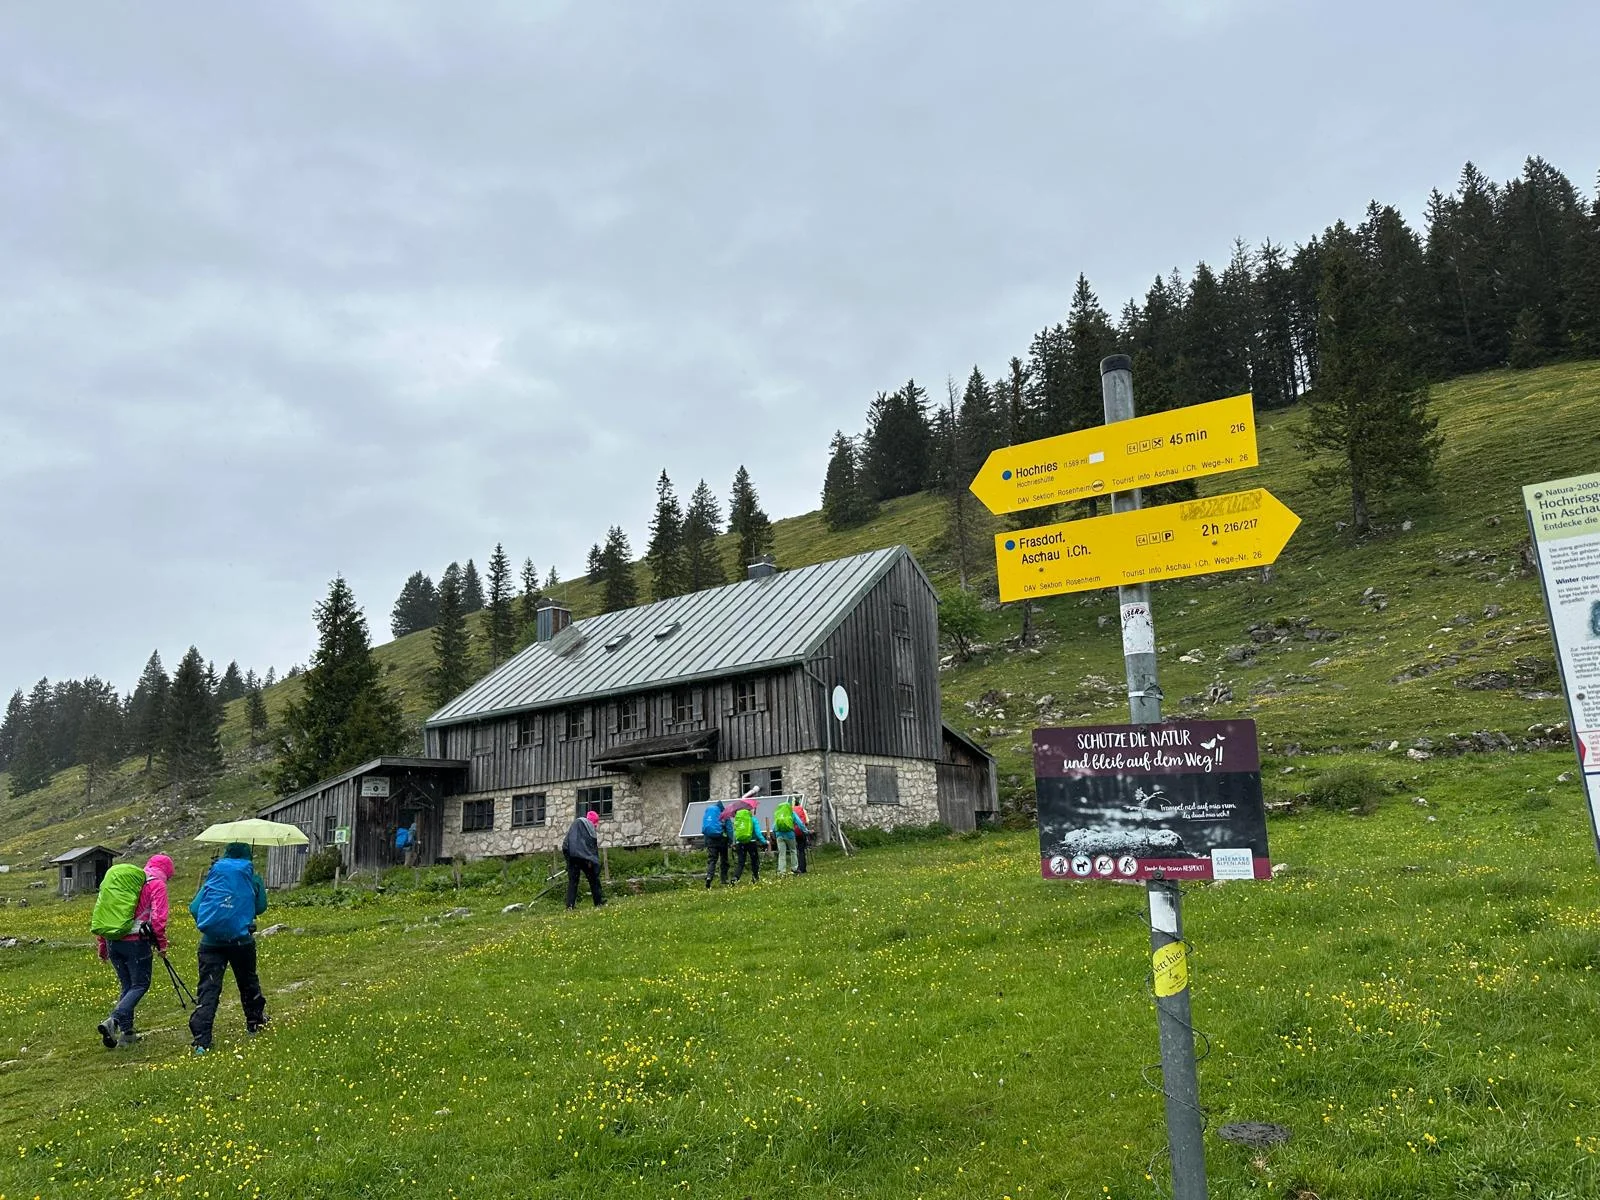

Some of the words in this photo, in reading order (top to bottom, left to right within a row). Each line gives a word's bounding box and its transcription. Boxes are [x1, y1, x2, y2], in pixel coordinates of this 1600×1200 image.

[1230, 422, 1246, 434] 216
[1170, 433, 1184, 446] 45
[1186, 429, 1208, 443] min
[1016, 461, 1058, 478] Hochries
[1112, 476, 1134, 486] Tourist
[1154, 468, 1178, 478] Aschau
[1239, 454, 1249, 462] 26
[1032, 492, 1054, 502] Sektion
[1058, 484, 1092, 496] Rosenheim
[1539, 492, 1600, 510] Hochriesg
[1541, 512, 1557, 520] im
[1202, 524, 1210, 537] 2
[1212, 522, 1220, 535] h
[1224, 518, 1258, 533] 216/217
[1544, 520, 1583, 530] Entdecke
[1164, 532, 1172, 541] P
[1022, 550, 1060, 565] Aschau
[1067, 544, 1092, 558] i.Ch.
[1122, 569, 1145, 578] Tourist
[1148, 566, 1162, 574] Info
[1166, 562, 1192, 572] Aschau
[1214, 553, 1249, 565] Wege-Nr.
[1252, 550, 1262, 560] 26
[1024, 584, 1037, 592] DAV
[1040, 580, 1063, 590] Sektion
[1066, 575, 1101, 586] Rosenheim
[1556, 576, 1579, 584] Winter
[1077, 731, 1127, 750] SCHÜTZE
[1130, 731, 1150, 748] DIE
[1150, 729, 1193, 748] NATUR
[1063, 752, 1092, 770] und
[1092, 752, 1126, 770] bleib
[1126, 752, 1152, 771] auf
[1153, 750, 1184, 767] dem
[1184, 802, 1196, 810] ned
[1197, 802, 1209, 812] auf
